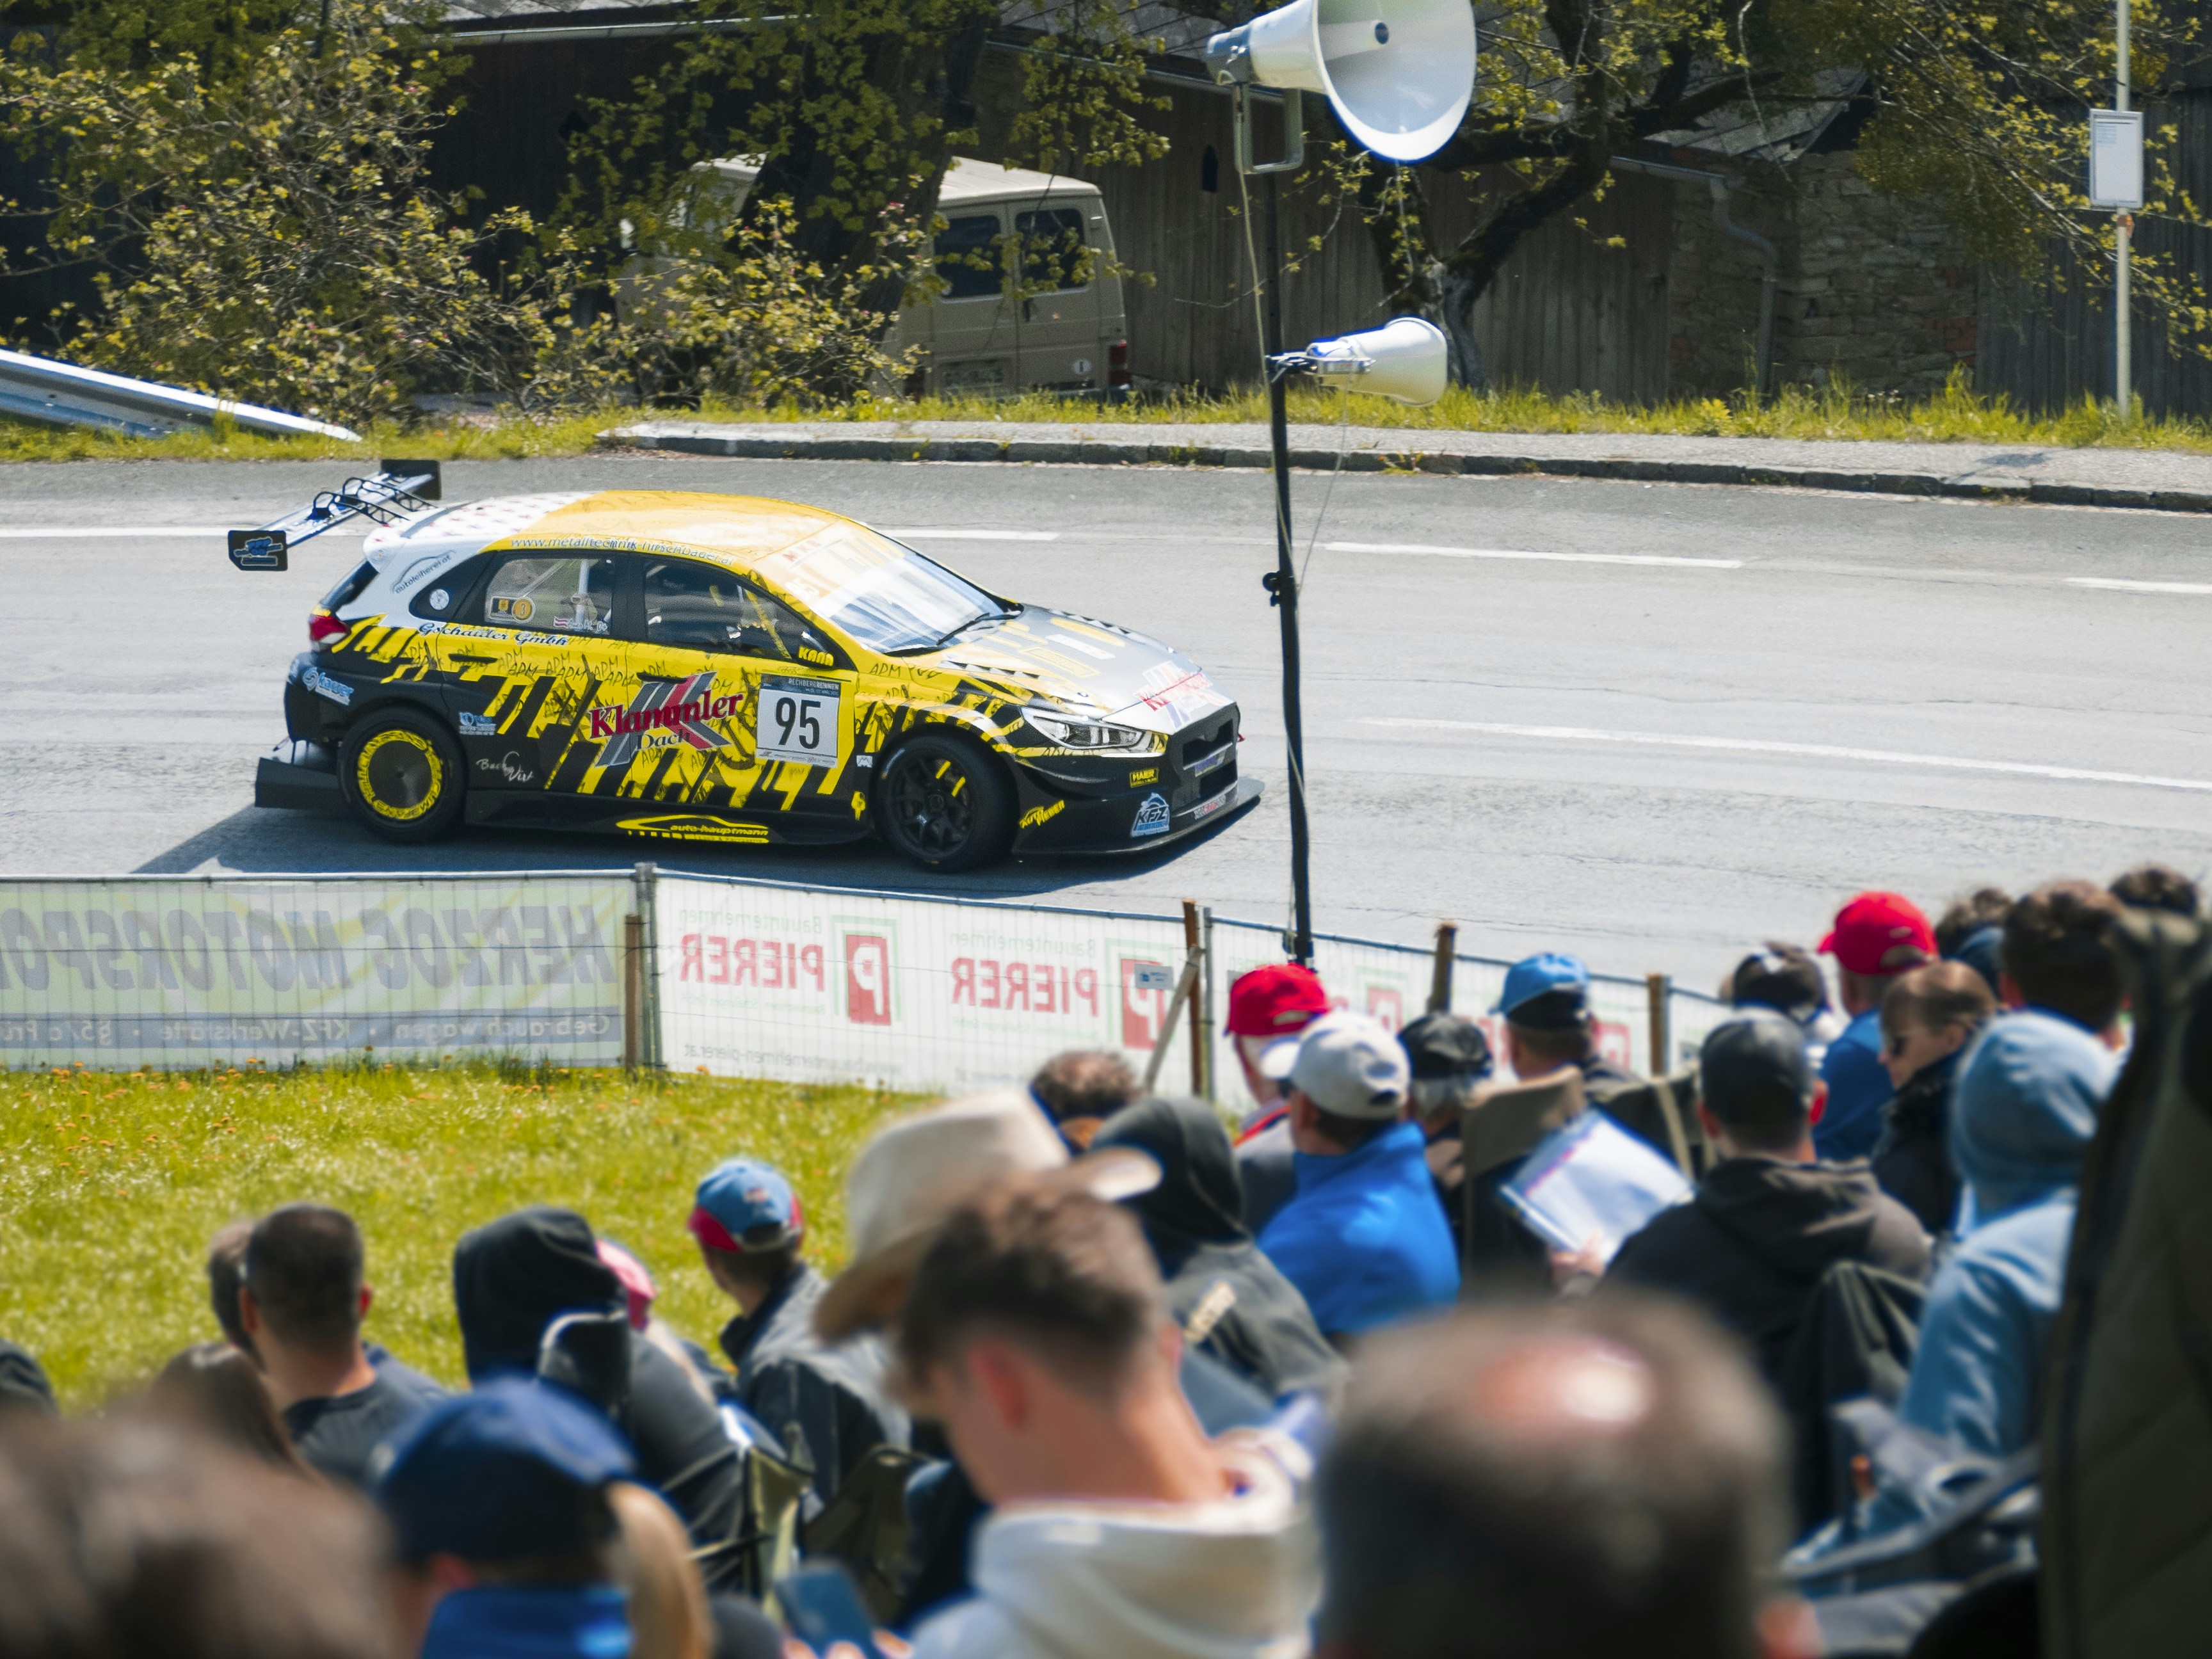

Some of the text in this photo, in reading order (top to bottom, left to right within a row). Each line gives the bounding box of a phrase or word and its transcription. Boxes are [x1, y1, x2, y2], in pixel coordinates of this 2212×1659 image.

[589, 690, 744, 739] Klammler
[775, 696, 821, 749] 95
[636, 728, 690, 750] Dach
[1136, 807, 1167, 830] KFZ
